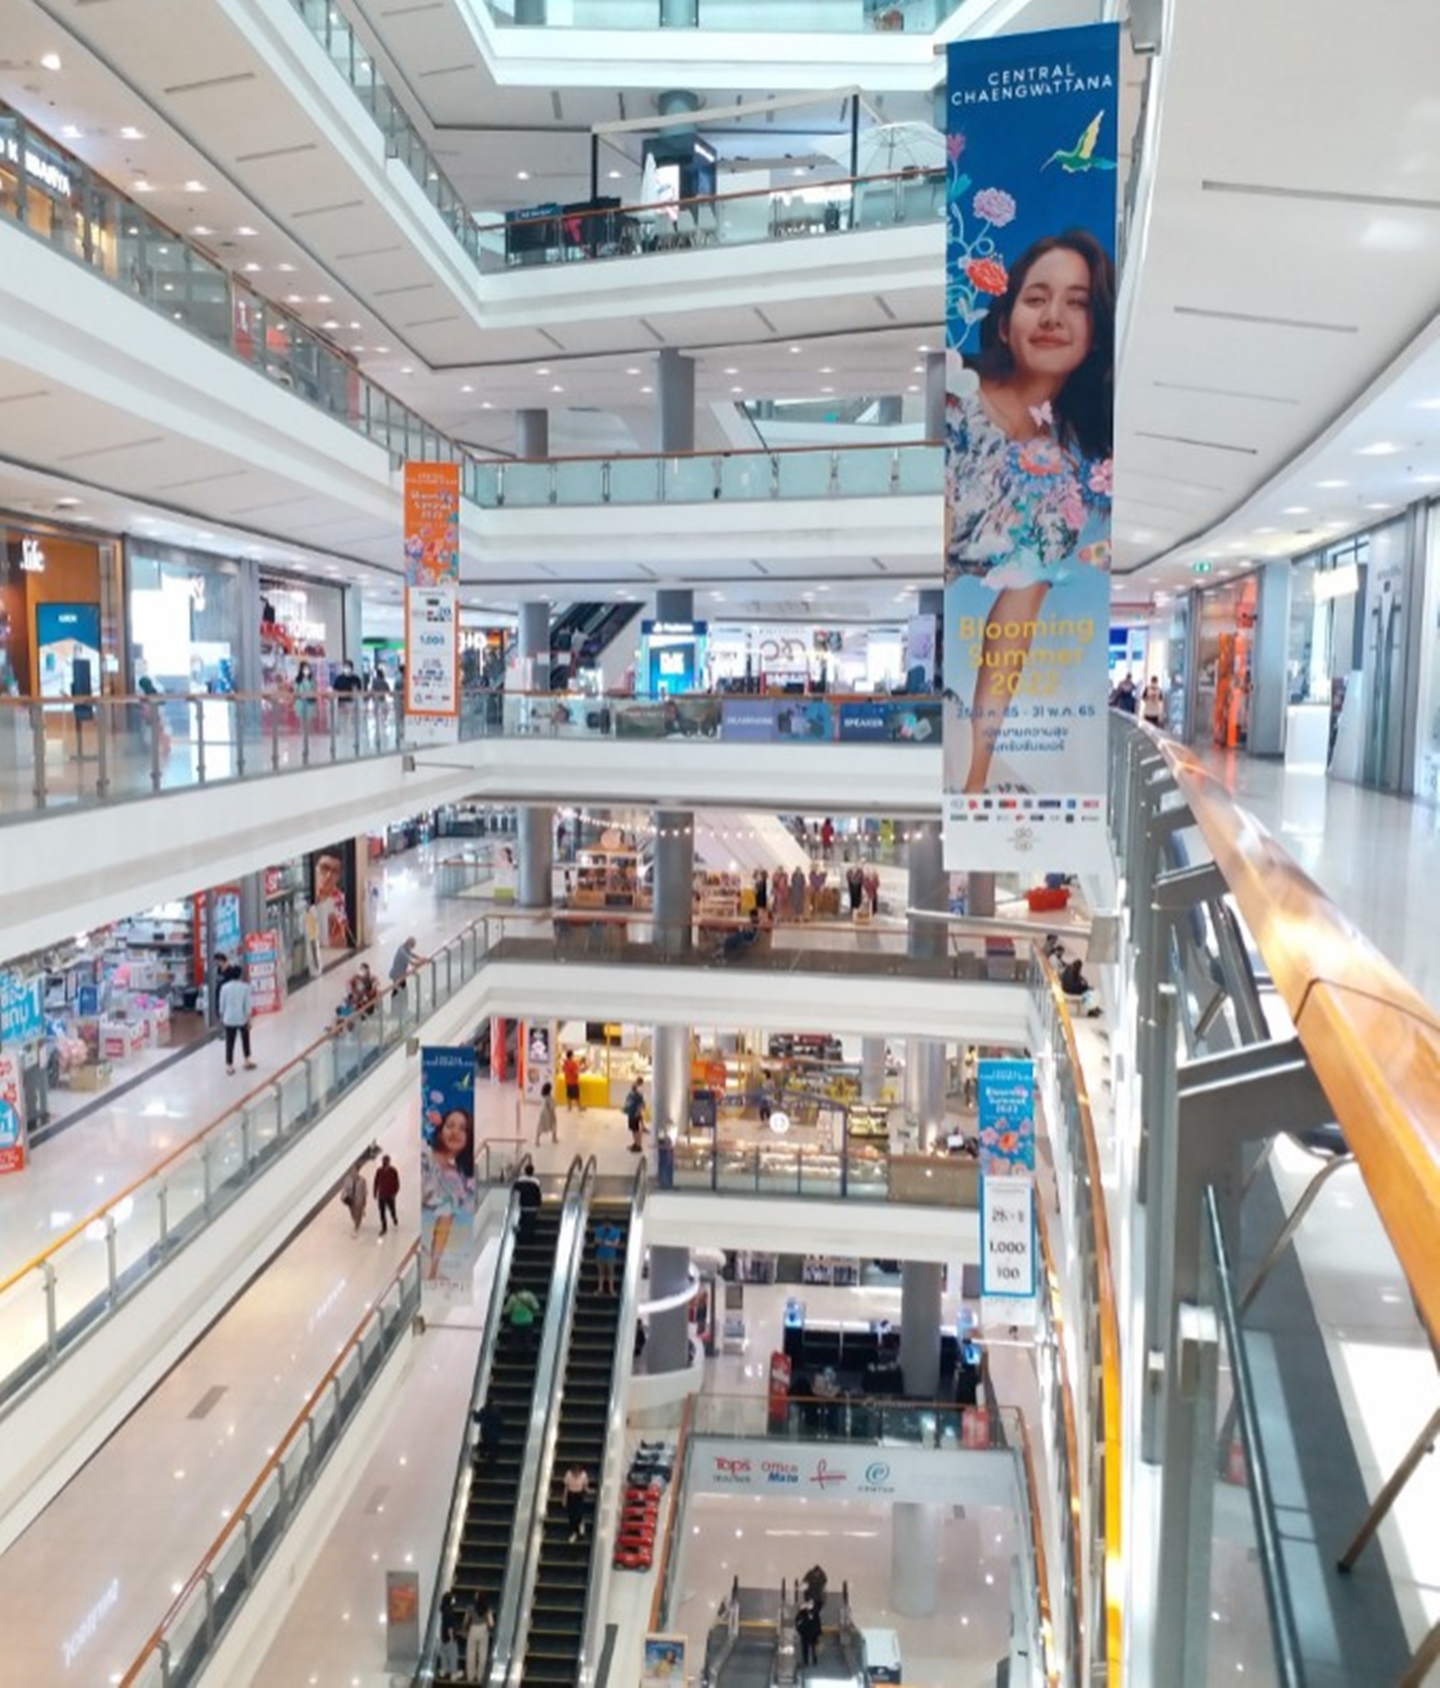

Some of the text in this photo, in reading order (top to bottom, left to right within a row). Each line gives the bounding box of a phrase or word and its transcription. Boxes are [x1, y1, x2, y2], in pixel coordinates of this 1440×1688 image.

[987, 63, 1076, 85] CENTRAL
[959, 612, 1095, 644] Blooming
[969, 645, 1084, 669] Summer
[990, 671, 1060, 695] 2022
[1078, 705, 1095, 717] 65
[844, 717, 885, 728] SPEAKER
[714, 1456, 752, 1475] Tops
